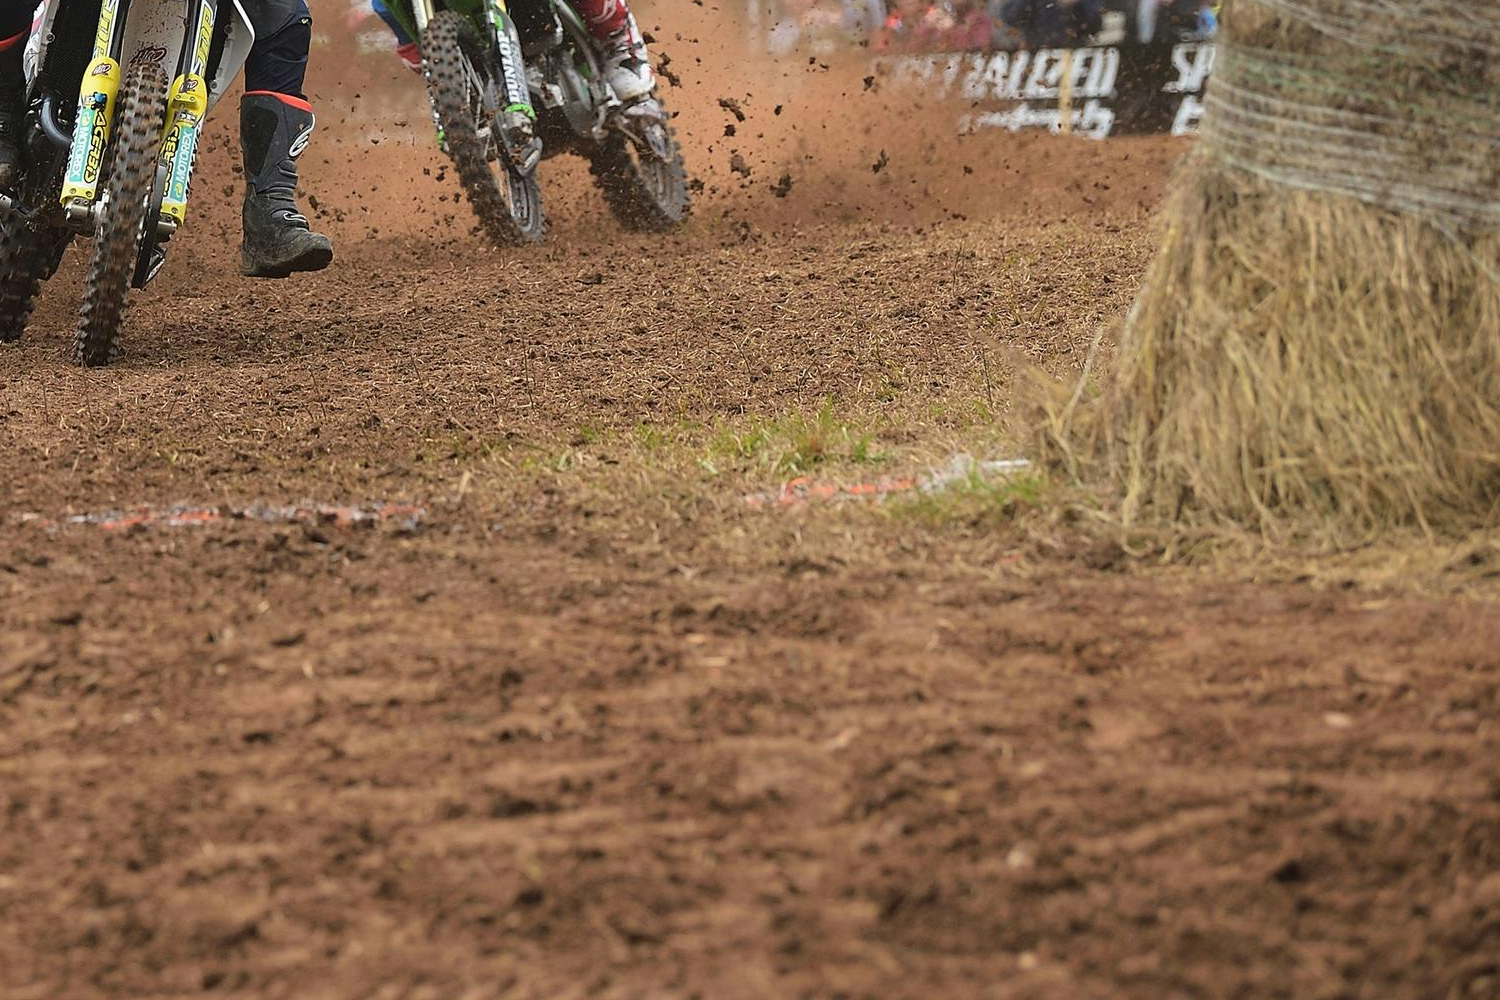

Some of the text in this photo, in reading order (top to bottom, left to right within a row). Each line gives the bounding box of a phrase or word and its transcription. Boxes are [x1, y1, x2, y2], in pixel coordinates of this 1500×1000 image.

[497, 30, 520, 103] DUNLOP
[84, 109, 108, 184] ACERBIS
[176, 131, 193, 183] MOTOREX
